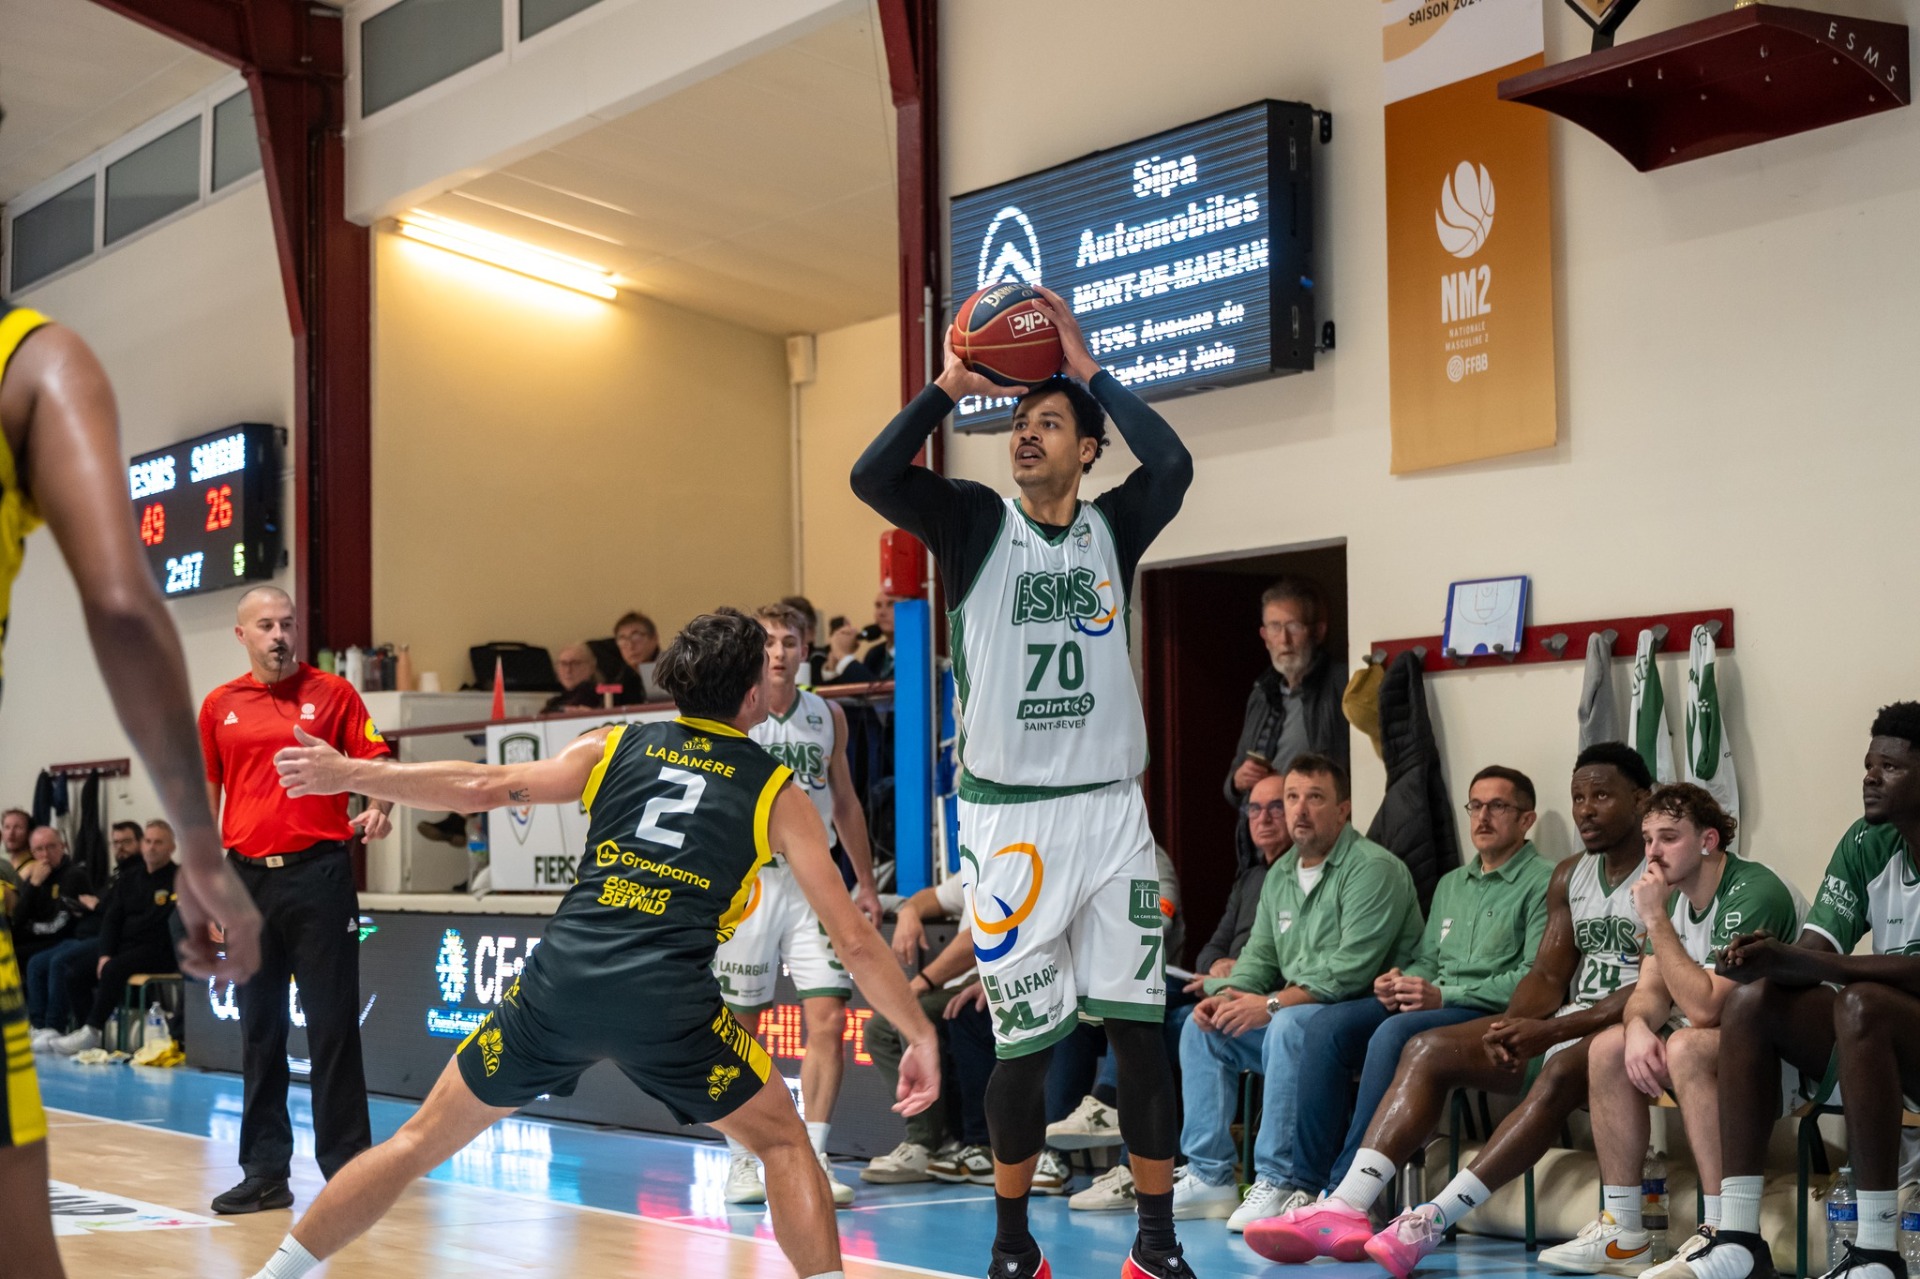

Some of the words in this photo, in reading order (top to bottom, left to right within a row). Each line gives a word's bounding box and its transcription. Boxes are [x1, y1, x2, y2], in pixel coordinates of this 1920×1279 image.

[1408, 2, 1449, 26] SAISON
[1133, 155, 1197, 198] Sipa
[1077, 193, 1259, 267] Automobiles
[1441, 264, 1491, 324] NM2
[1141, 310, 1213, 345] Avenue
[1445, 335, 1482, 351] MASCULINE
[1465, 353, 1488, 375] FFBB
[140, 502, 165, 546] 49
[205, 483, 233, 533] 26
[1012, 567, 1101, 625] ESMS
[1025, 641, 1084, 691] 70
[1023, 699, 1071, 718] point
[1024, 718, 1086, 732] SAINT-SEVER
[645, 744, 736, 778] LABANÈRE
[760, 741, 824, 778] SMS
[635, 766, 707, 849] 2
[534, 855, 576, 885] FIERS
[603, 875, 651, 897] BORN
[621, 851, 711, 890] Groupama
[1575, 915, 1641, 956] ESMS
[720, 959, 769, 977] LAFARGUE
[1581, 959, 1622, 994] 24
[995, 1001, 1049, 1036] XL
